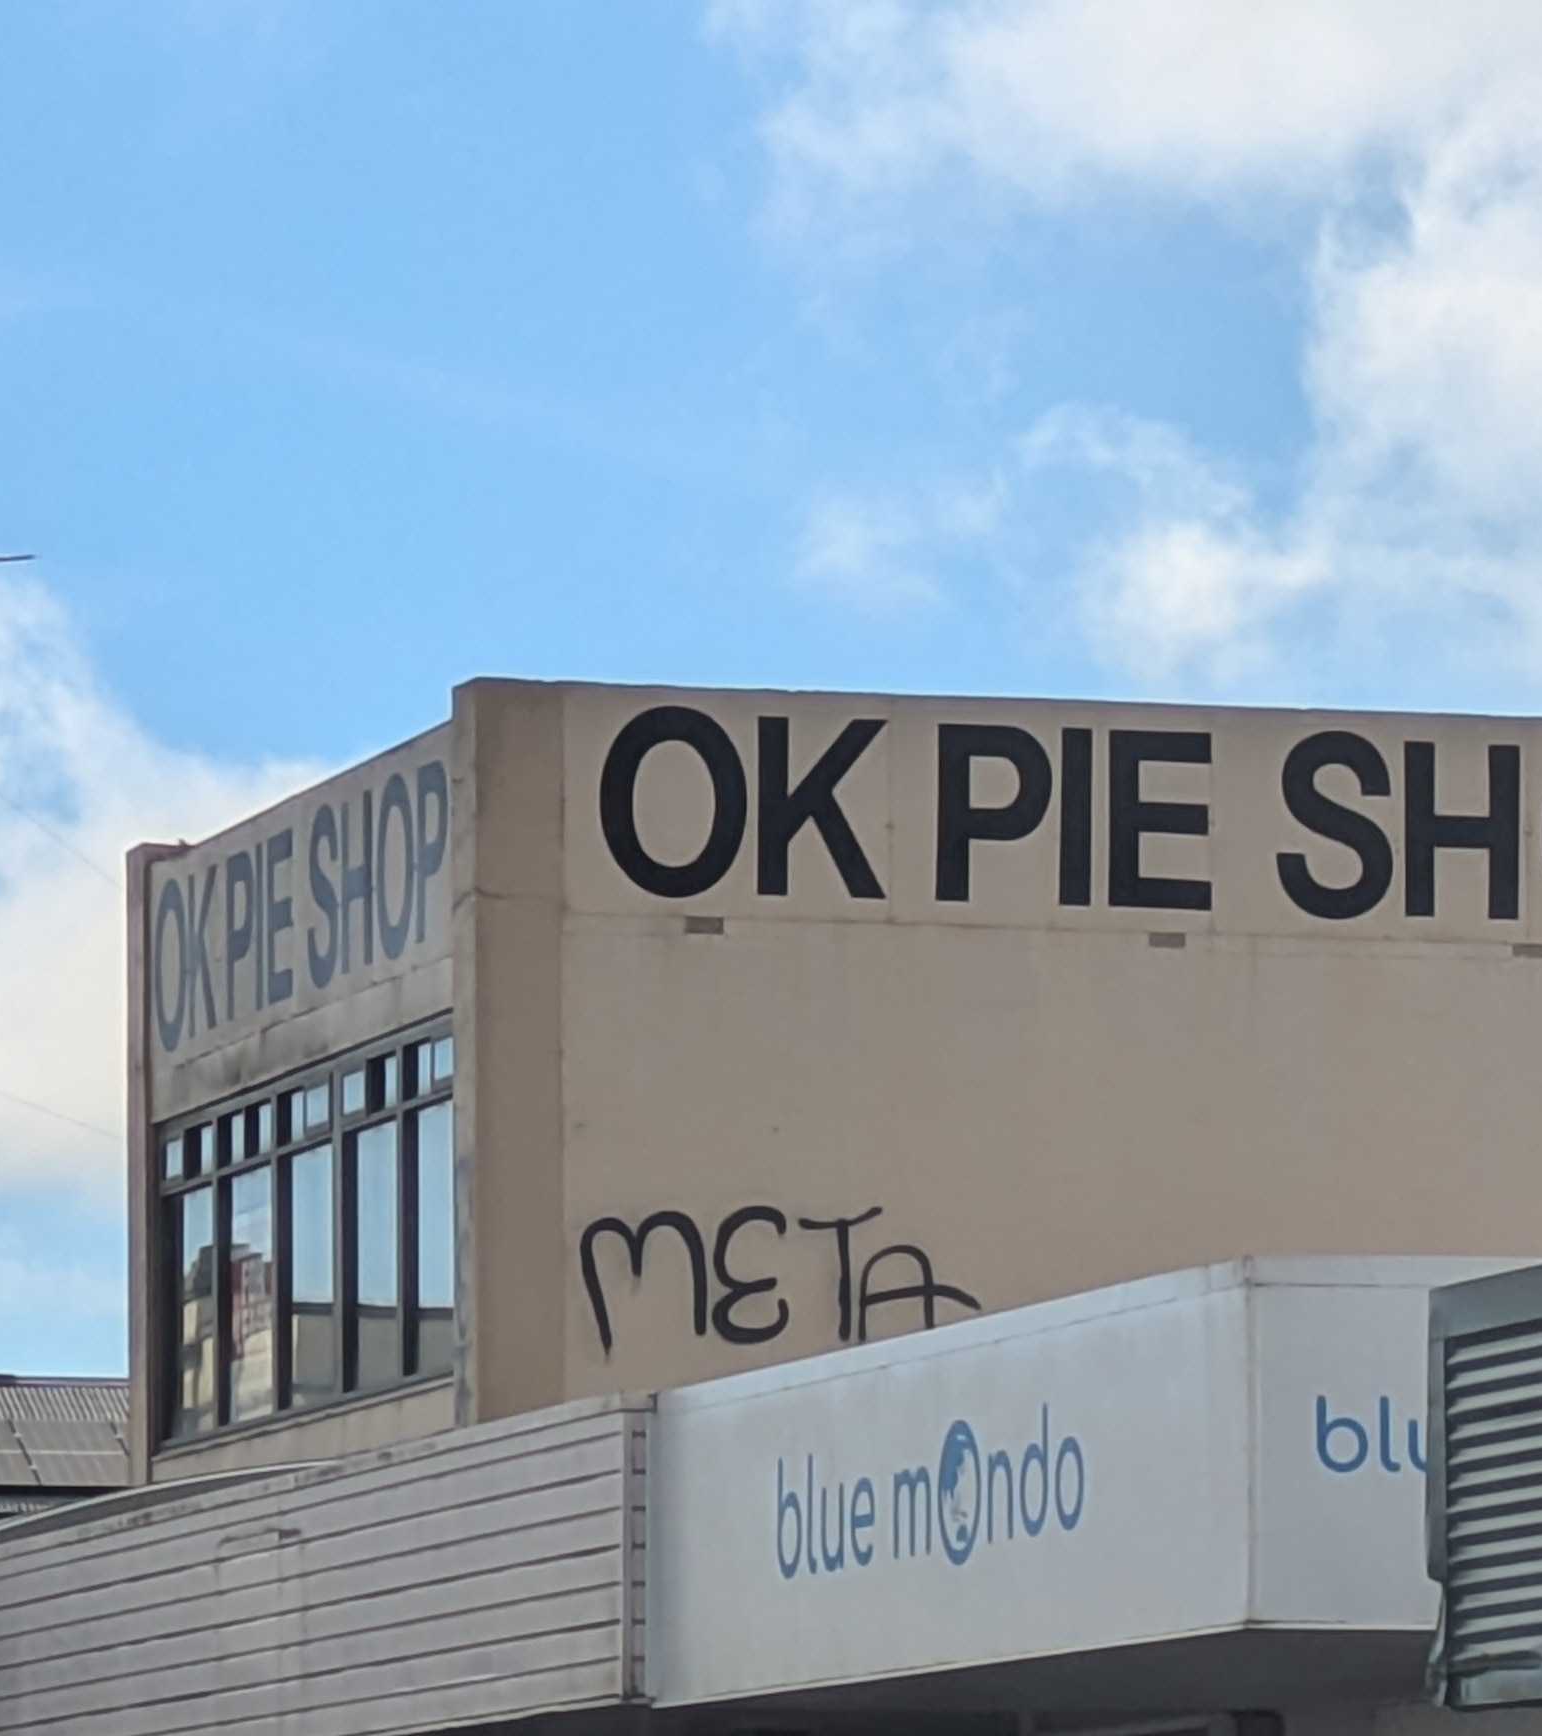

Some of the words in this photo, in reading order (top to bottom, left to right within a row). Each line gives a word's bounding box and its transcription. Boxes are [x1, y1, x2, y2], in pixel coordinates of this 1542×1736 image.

[599, 705, 888, 899] OK
[935, 723, 1213, 912] PIE
[155, 863, 218, 1052] OK
[225, 827, 294, 1022] PIE
[306, 759, 449, 989] SHOP
[579, 1205, 982, 1360] META
[777, 1452, 876, 1580] blue
